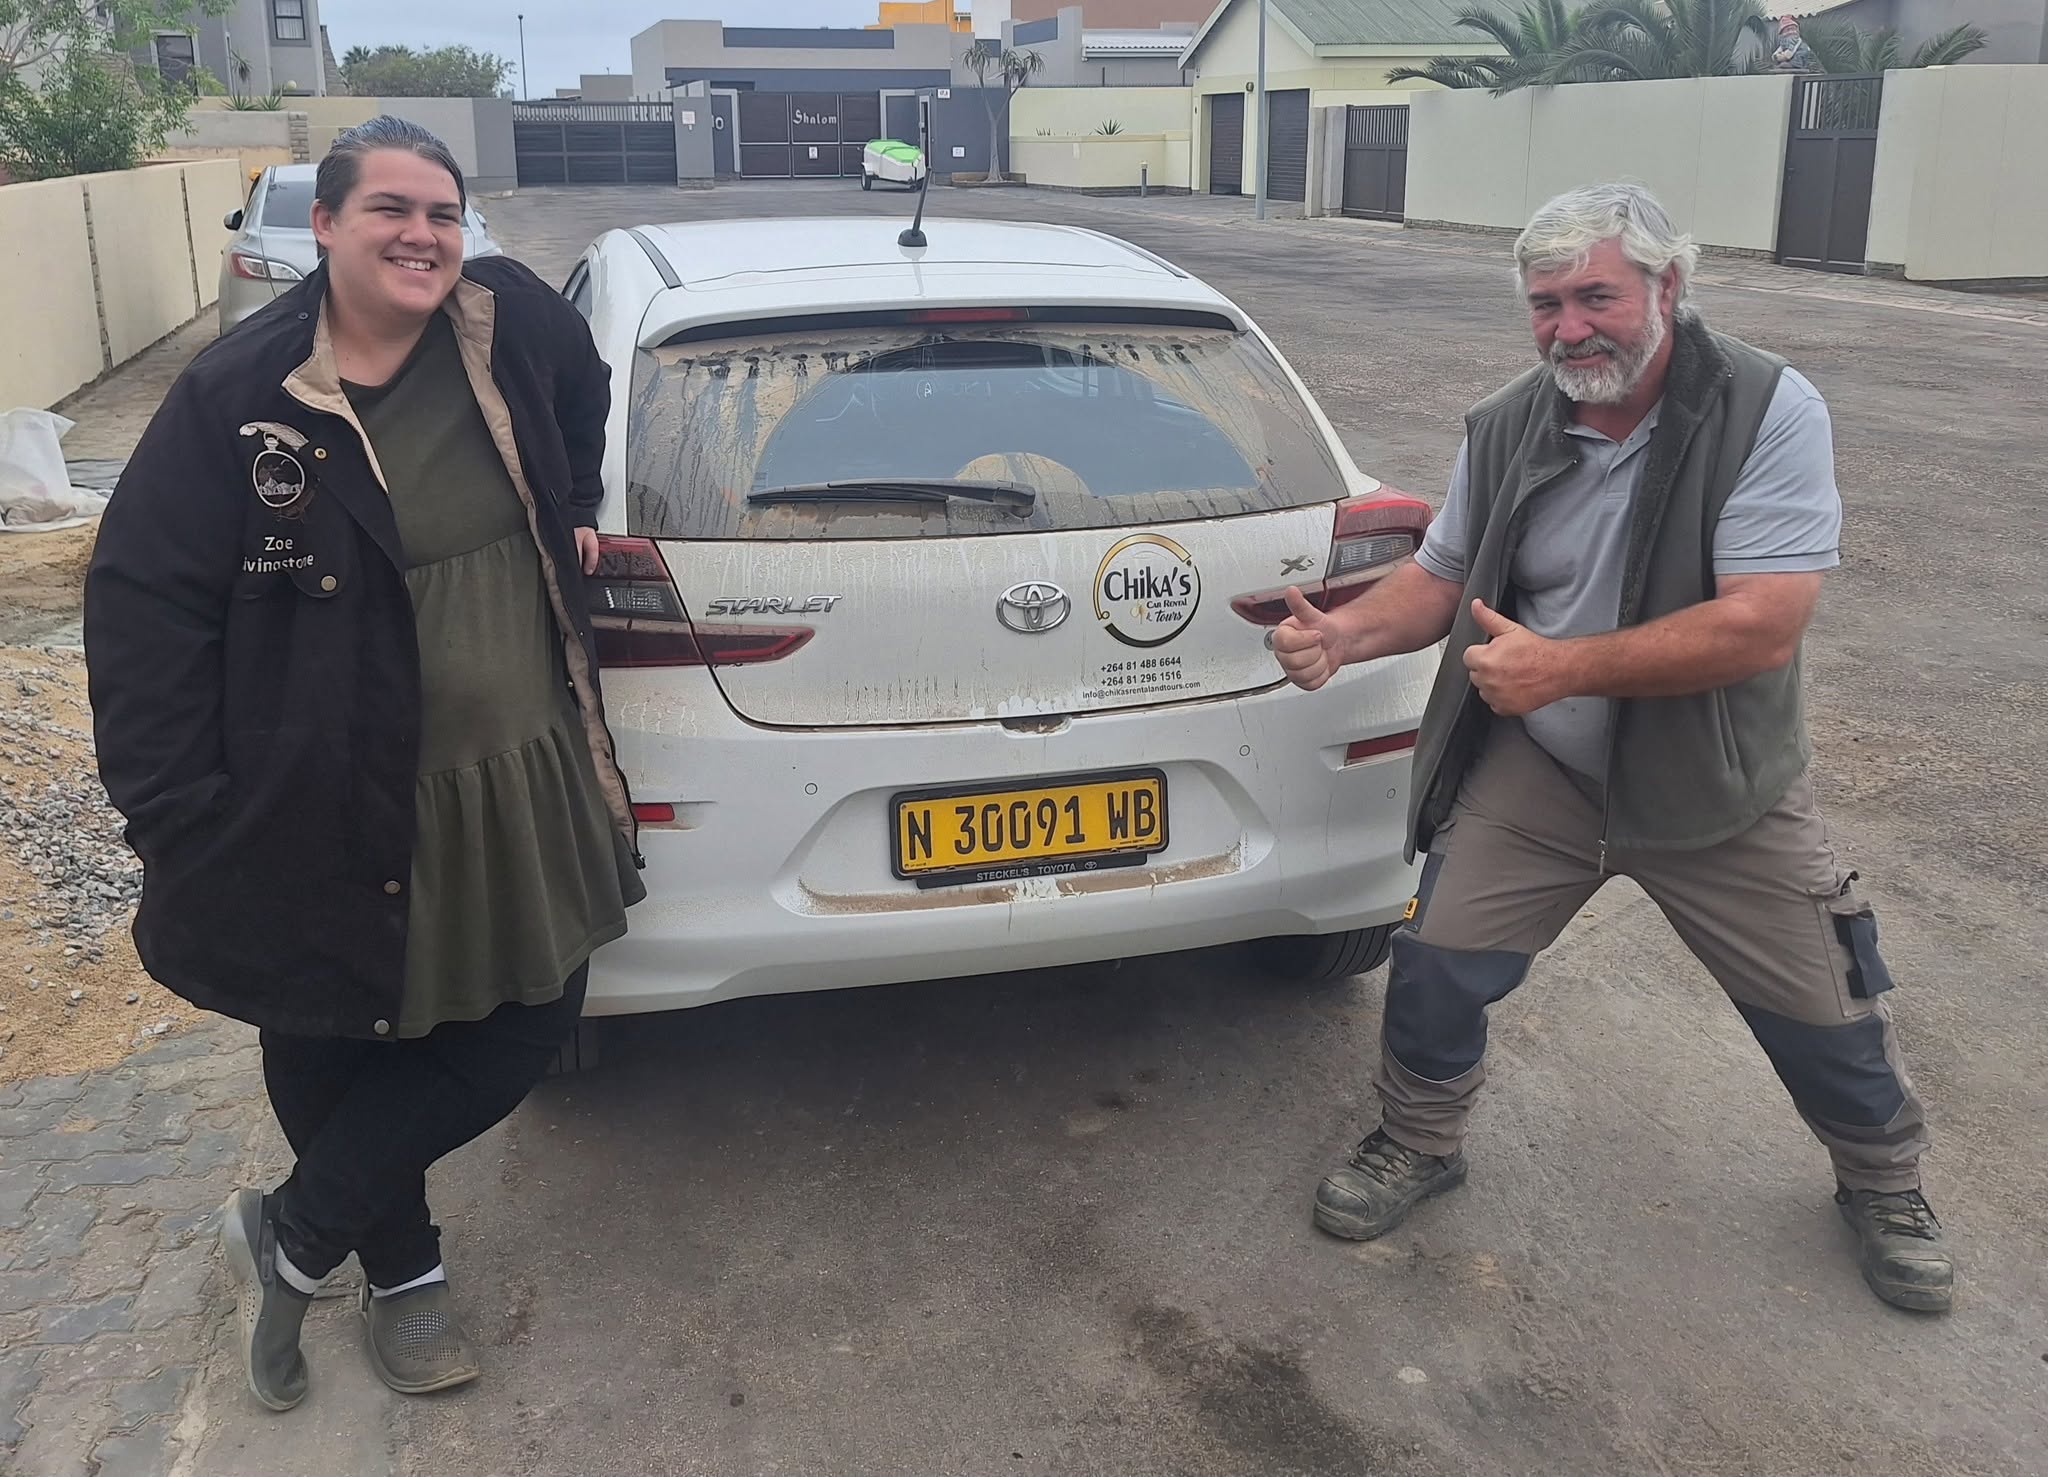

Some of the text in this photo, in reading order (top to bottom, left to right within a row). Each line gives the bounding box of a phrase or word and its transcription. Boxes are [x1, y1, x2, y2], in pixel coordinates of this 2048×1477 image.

[792, 109, 837, 125] Shalom
[264, 536, 294, 551] Zoe
[242, 554, 314, 573] ivingstone
[704, 593, 844, 617] STARLET
[1100, 656, 1182, 673] +264 81 488 6644
[1100, 670, 1182, 687] +264 81 296 1516
[1082, 681, 1201, 699] info@chikasrentalandtours.com
[907, 788, 1157, 861] N 30091 WB
[976, 862, 1077, 882] STECKEL'S TOYOTA
